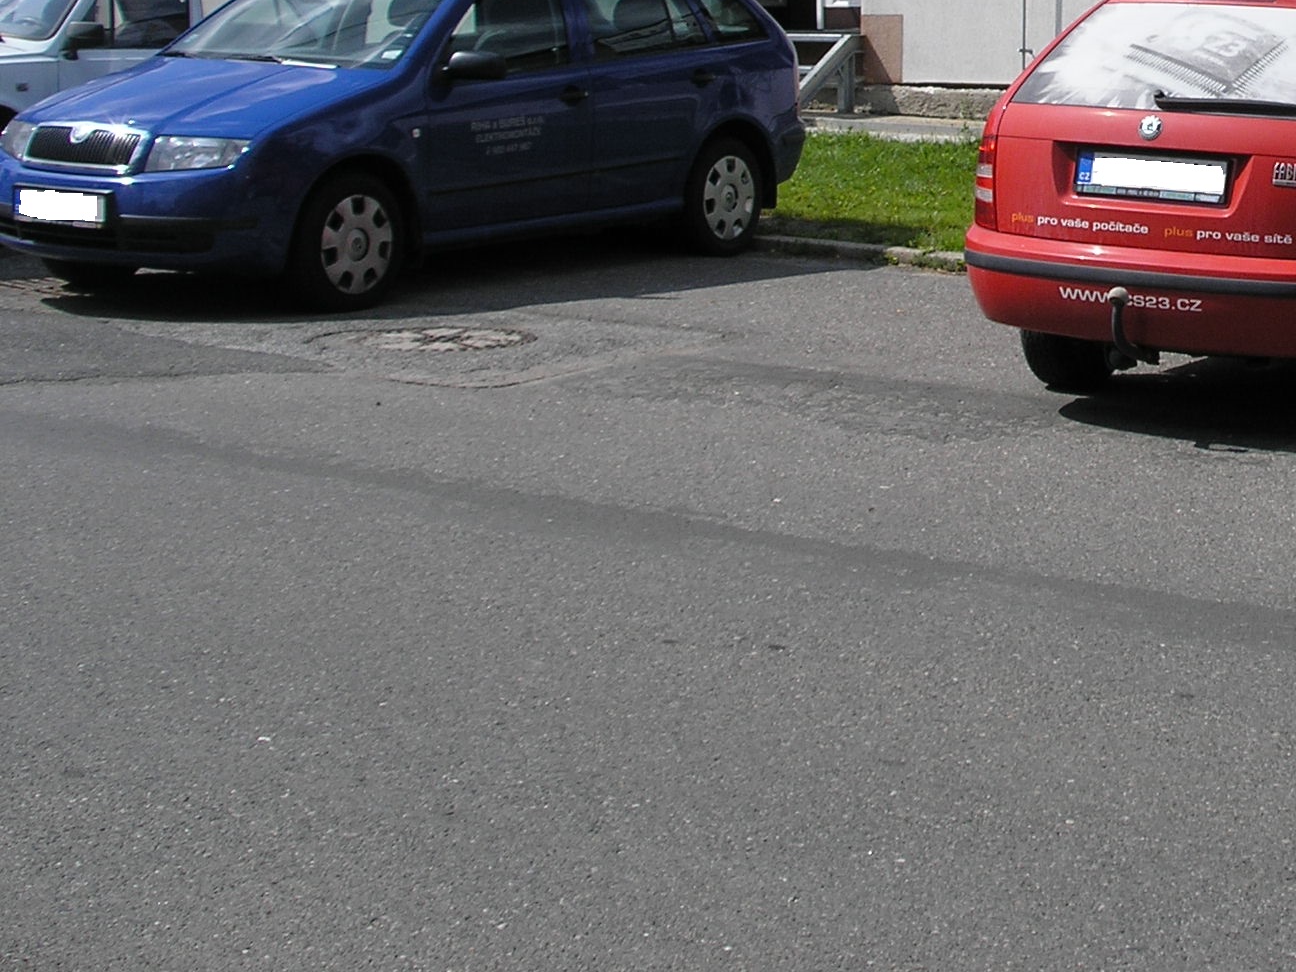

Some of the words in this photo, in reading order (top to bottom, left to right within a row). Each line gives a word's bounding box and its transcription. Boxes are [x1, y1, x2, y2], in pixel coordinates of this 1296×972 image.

[1078, 171, 1091, 181] CZ
[1011, 212, 1034, 224] plus
[1037, 215, 1058, 226] pro
[1060, 217, 1089, 229] vaše
[1092, 220, 1149, 234] počítače
[1164, 226, 1193, 238] plus
[1196, 229, 1221, 240] pro
[1225, 231, 1260, 243] vaše
[1264, 233, 1293, 245] sítě
